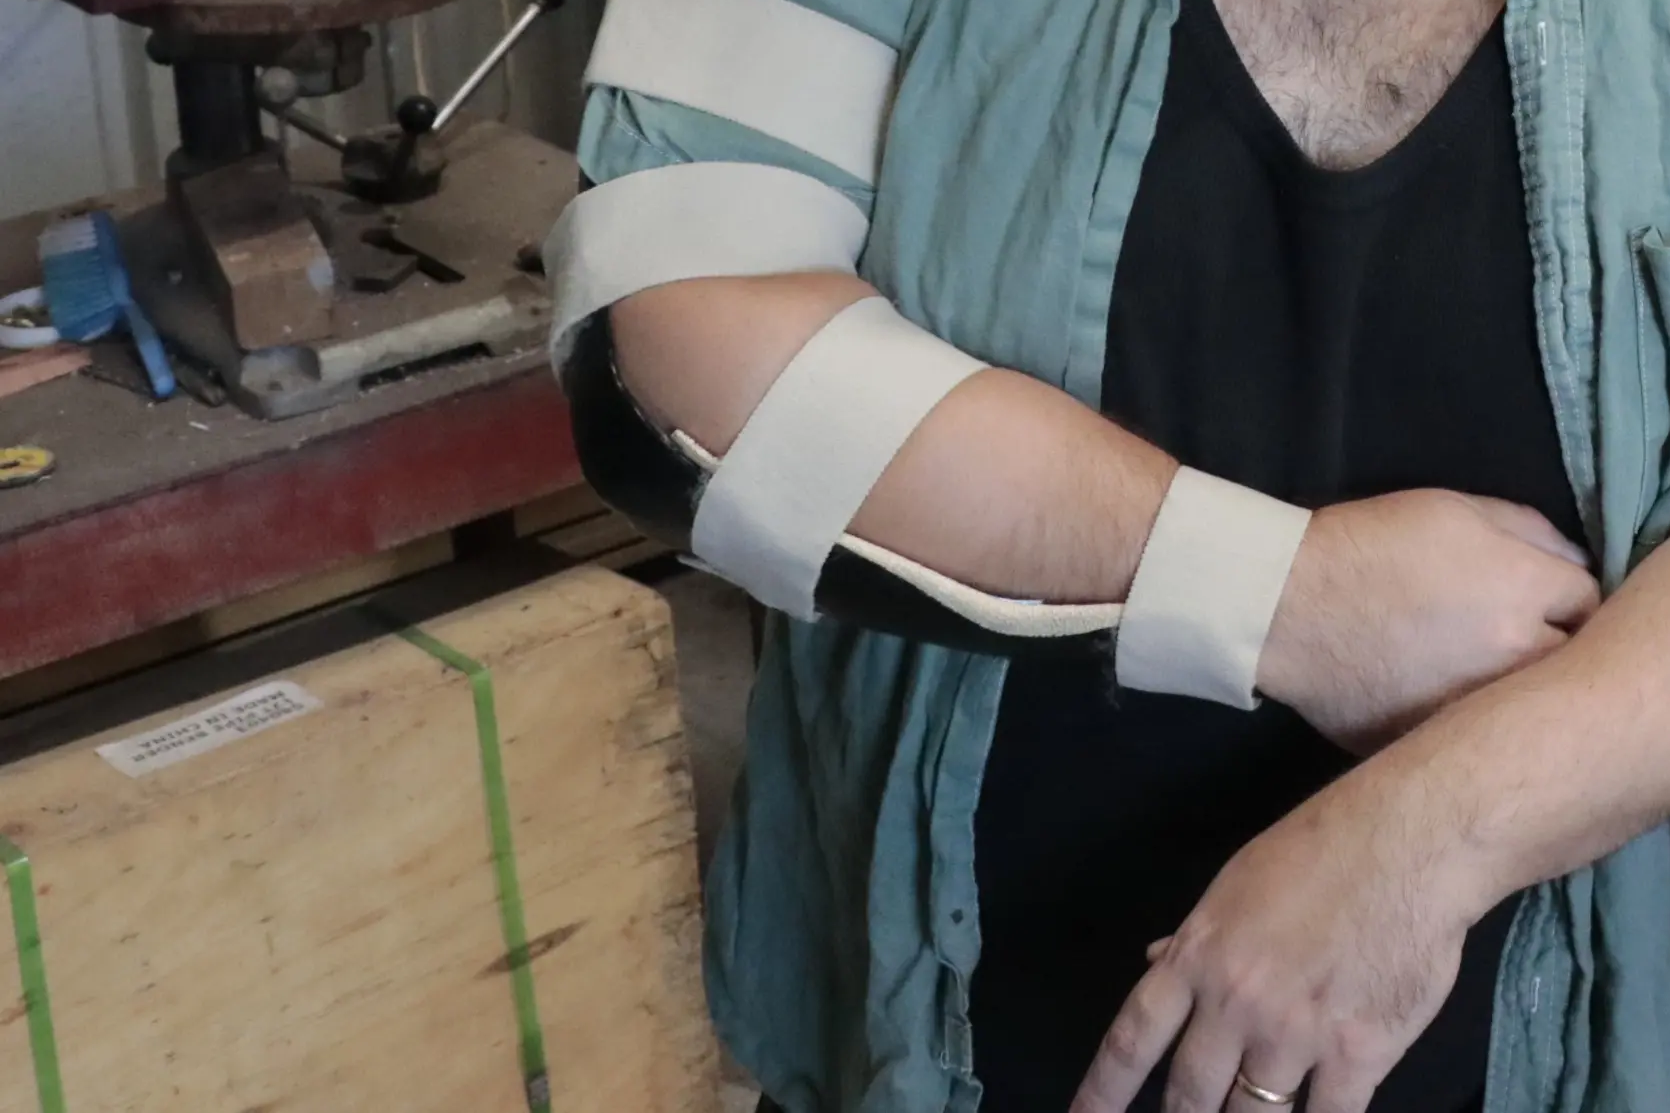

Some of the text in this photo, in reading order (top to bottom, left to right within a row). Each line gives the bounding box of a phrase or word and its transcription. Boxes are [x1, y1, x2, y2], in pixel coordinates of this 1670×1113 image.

[138, 690, 285, 748] MADE IN CHINA
[212, 710, 258, 732] PIPE
[132, 730, 209, 762] BENDER
